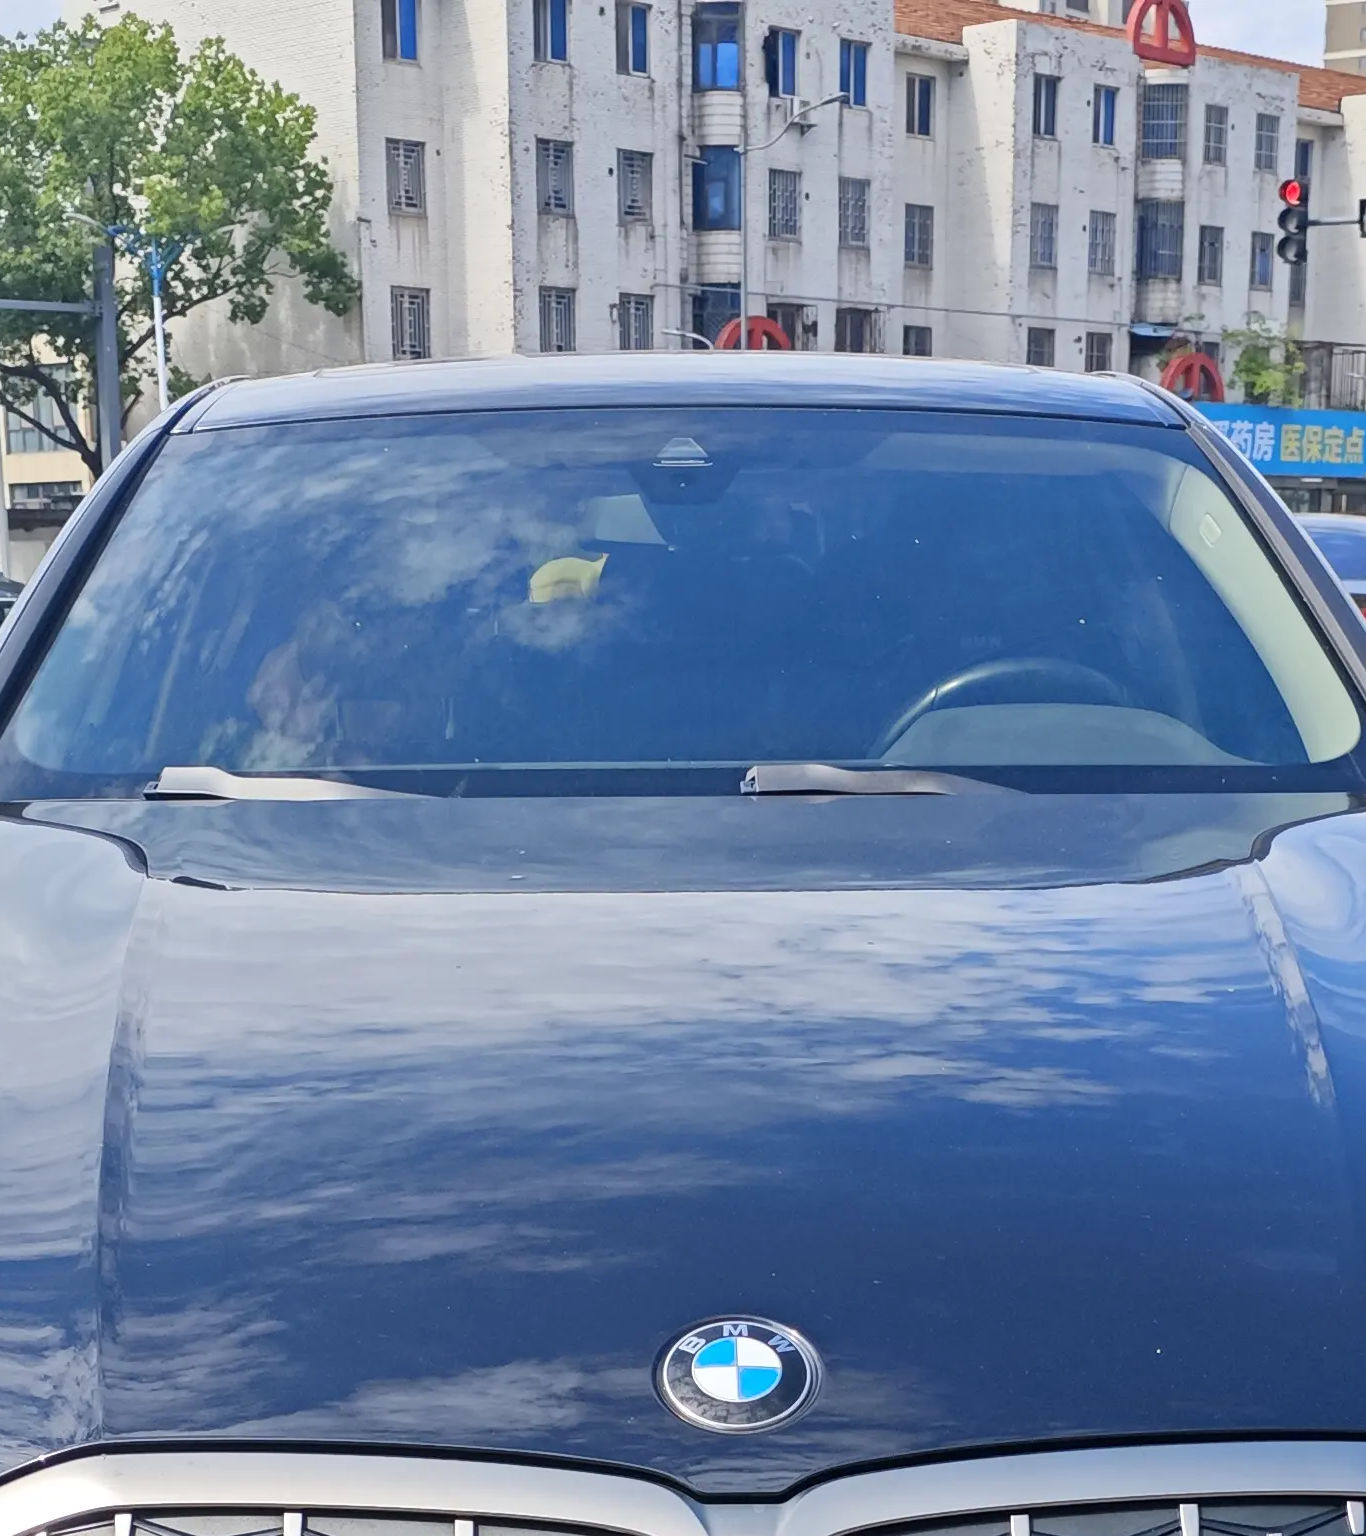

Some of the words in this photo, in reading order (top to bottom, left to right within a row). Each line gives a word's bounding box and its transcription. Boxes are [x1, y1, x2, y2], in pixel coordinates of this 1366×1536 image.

[1280, 424, 1365, 464] 医保定点
[679, 1324, 795, 1354] BMW
